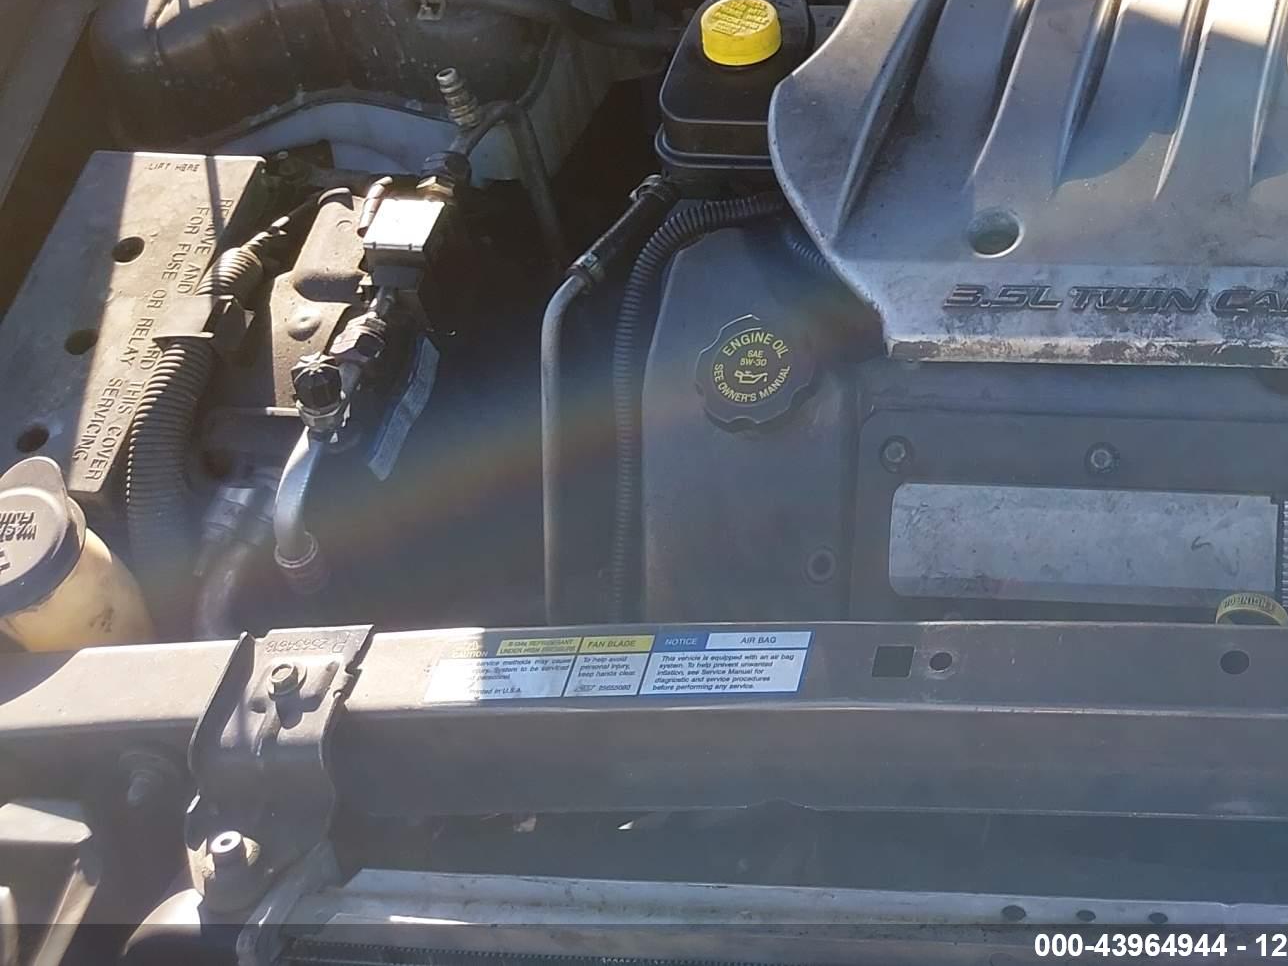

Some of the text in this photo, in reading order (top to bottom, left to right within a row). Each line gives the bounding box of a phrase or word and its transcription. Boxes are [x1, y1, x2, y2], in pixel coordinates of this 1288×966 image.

[184, 207, 209, 234] FOR
[161, 244, 192, 280] FUSE
[177, 264, 201, 294] AND
[146, 289, 167, 309] OR
[943, 283, 1064, 312] 3.5L
[1069, 285, 1208, 315] TWIN
[120, 318, 155, 368] RELAY
[723, 332, 792, 359] ENGINE OIL
[747, 350, 764, 358] SAE
[740, 358, 767, 366] 5W-30
[714, 363, 791, 402] SEE OWNER'S MANUAL
[118, 381, 146, 415] THIS
[72, 378, 123, 461] SERVICING
[85, 426, 123, 480] COVER
[608, 640, 636, 648] BLADE
[665, 637, 697, 645] NOTICE
[758, 636, 777, 644] BAG
